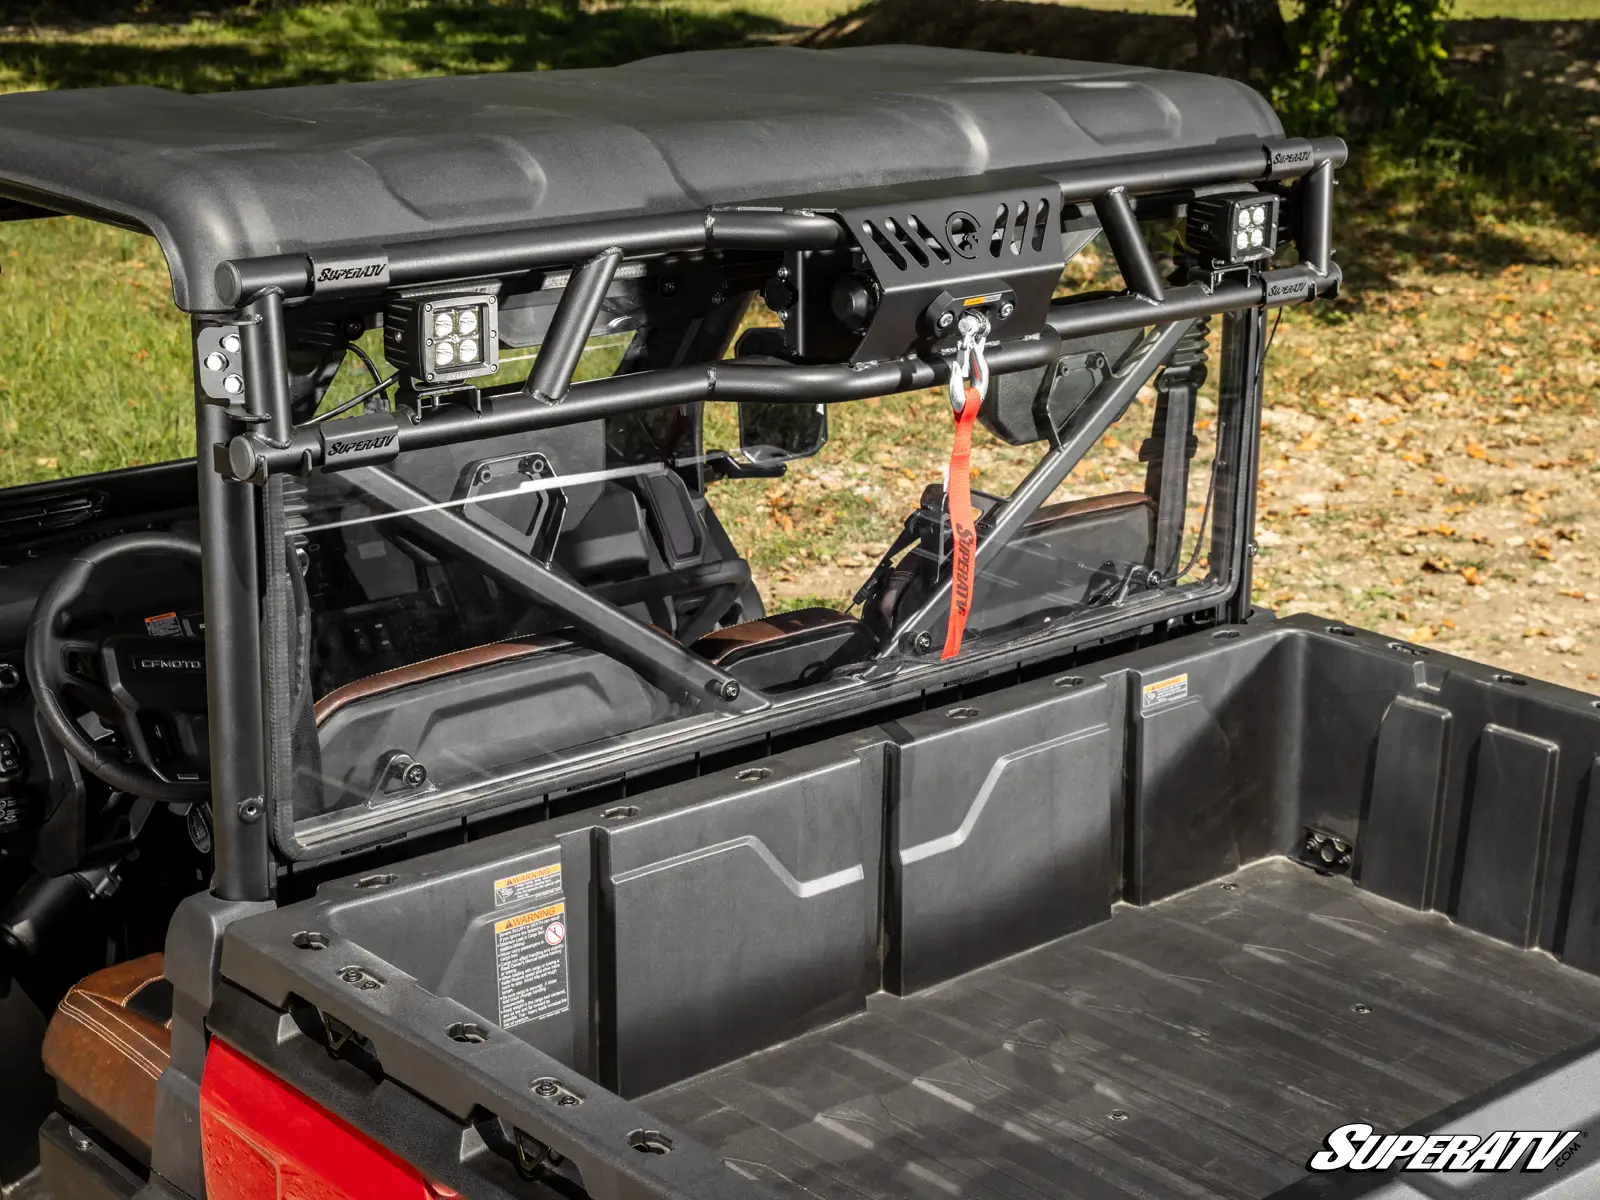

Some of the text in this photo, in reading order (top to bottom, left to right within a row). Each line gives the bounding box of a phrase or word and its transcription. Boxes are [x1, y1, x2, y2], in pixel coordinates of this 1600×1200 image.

[1273, 151, 1311, 165] SUPERATV
[317, 263, 386, 282] SUPERATV
[328, 434, 395, 456] SUPERATV
[955, 523, 974, 613] SUPERATV
[141, 660, 201, 668] CFMOTO
[512, 867, 551, 883] WARNING
[512, 906, 556, 926] WARNING
